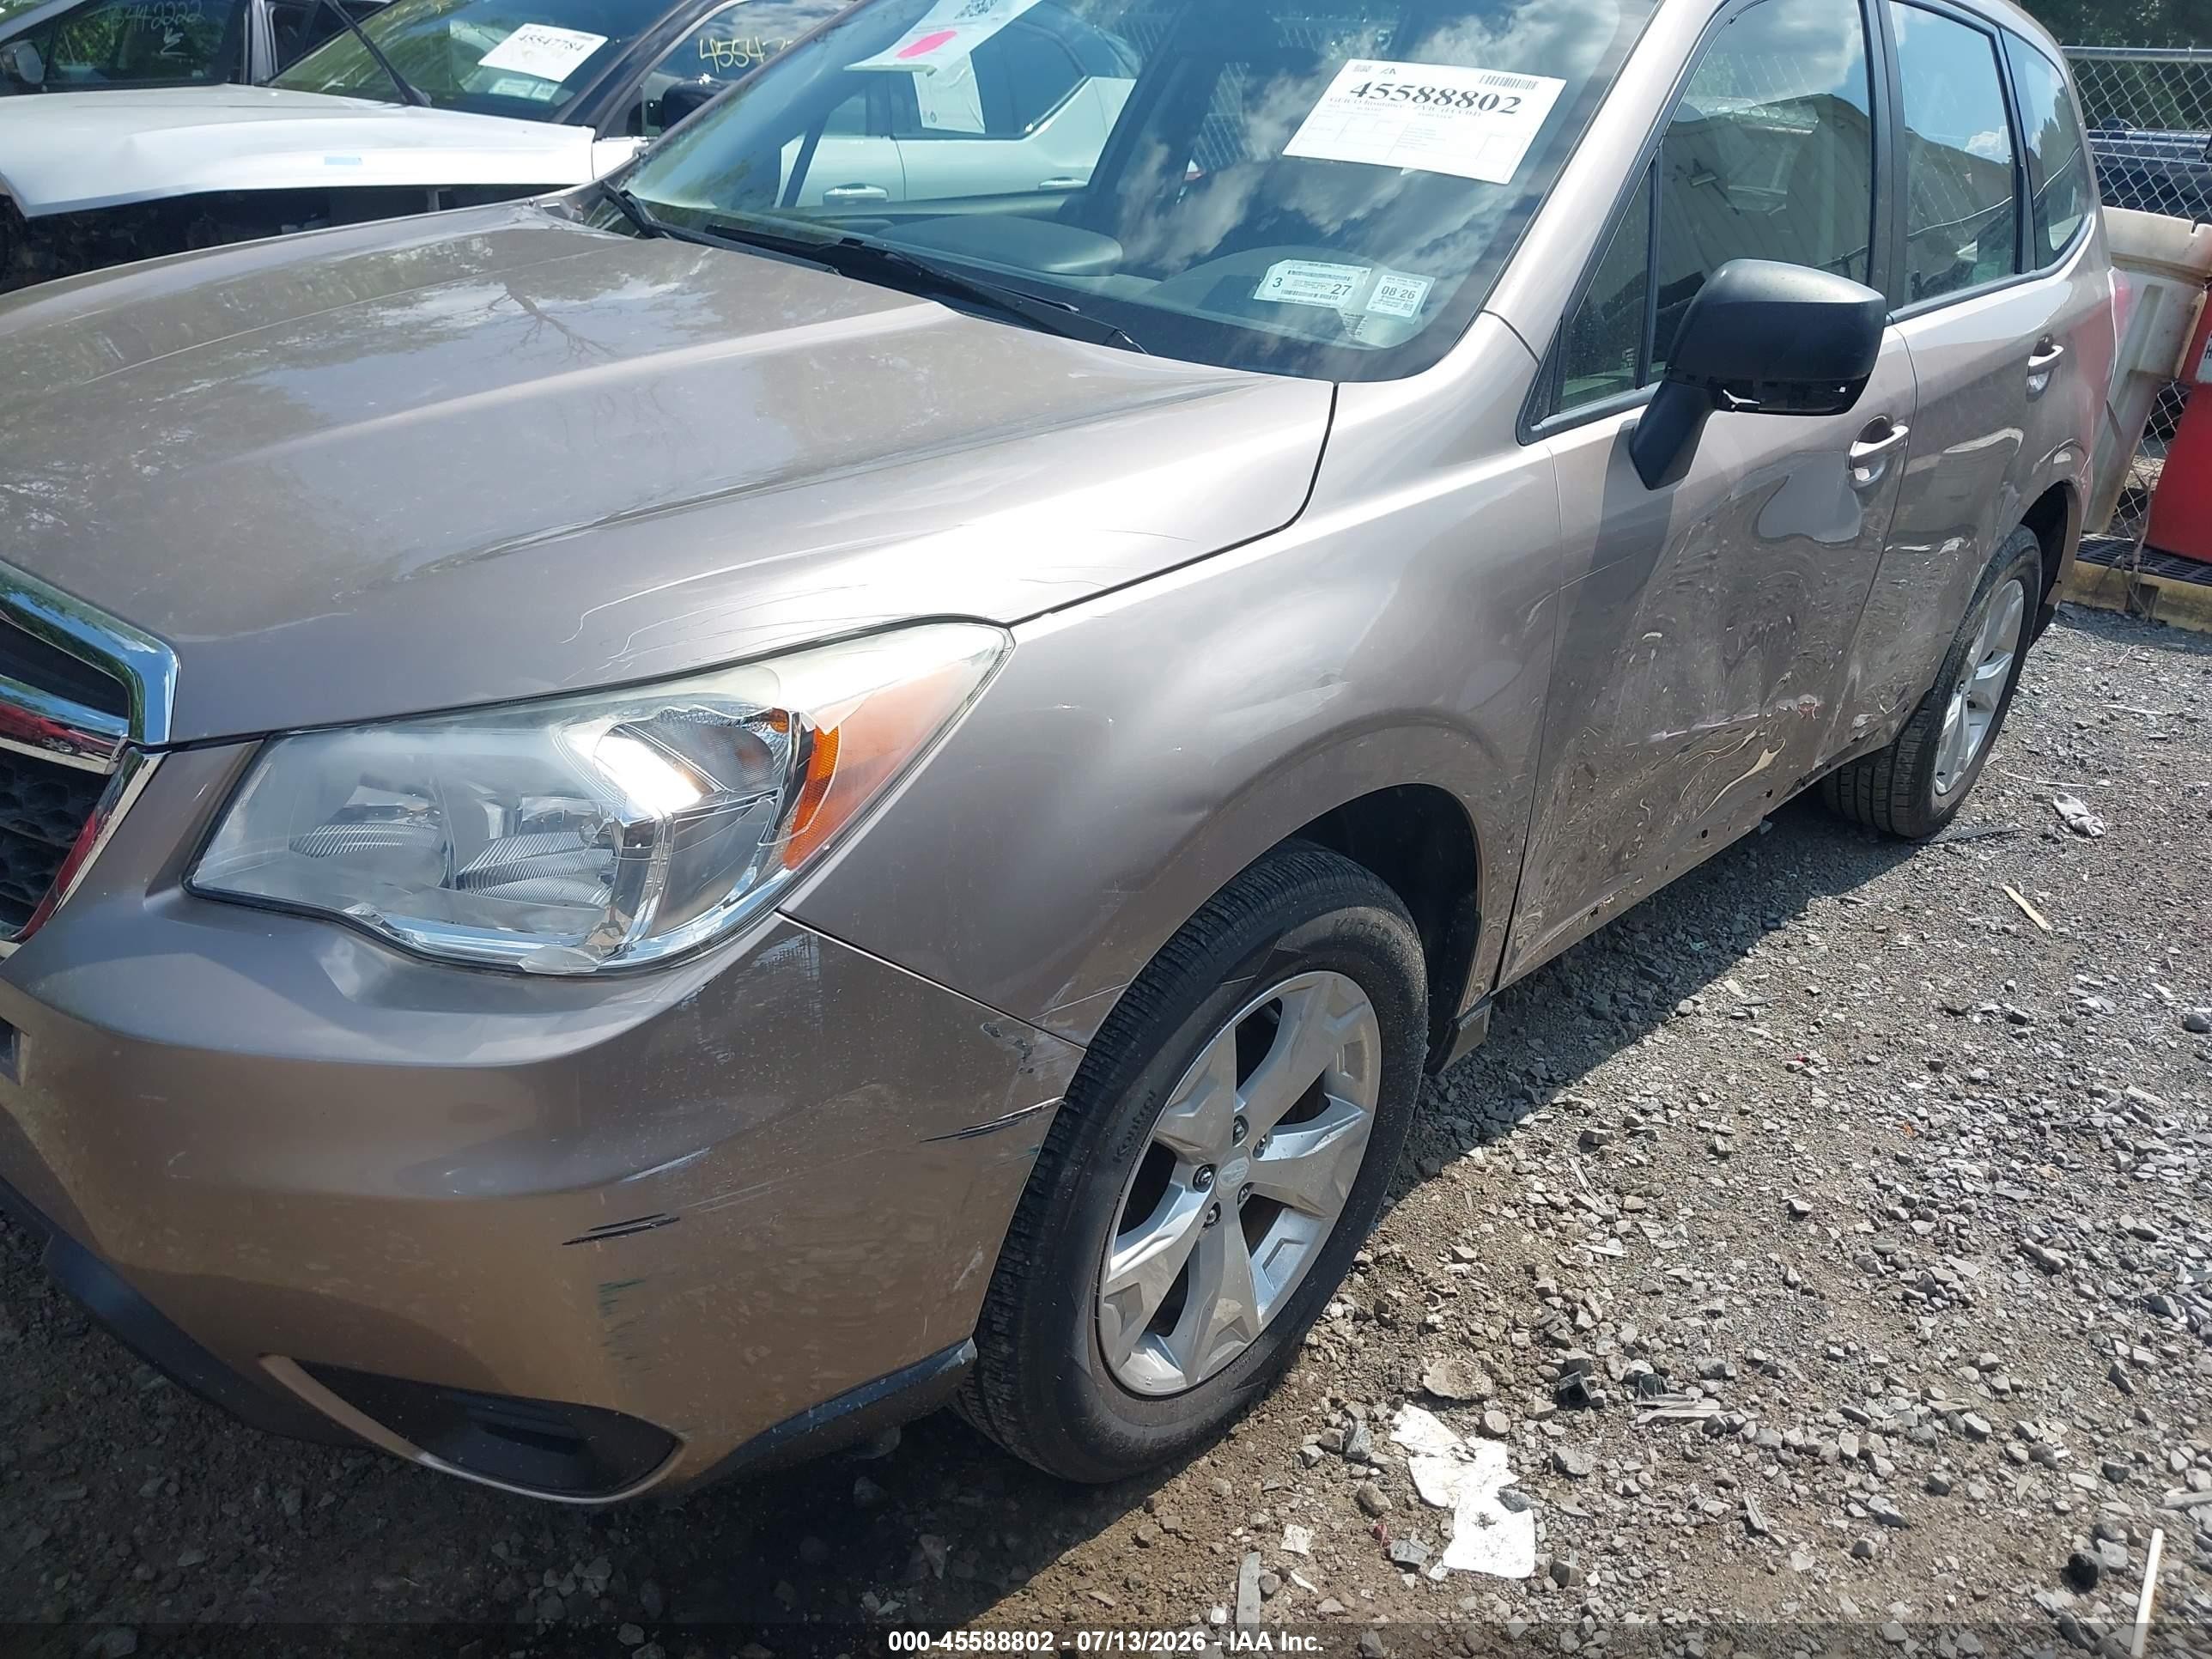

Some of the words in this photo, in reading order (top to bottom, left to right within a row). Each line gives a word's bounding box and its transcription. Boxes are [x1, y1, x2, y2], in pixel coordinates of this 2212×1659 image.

[1350, 81, 1522, 114] 45588802
[1272, 276, 1284, 289] 3
[1331, 283, 1352, 296] 27
[1381, 285, 1399, 296] 08
[1400, 289, 1417, 300] 26
